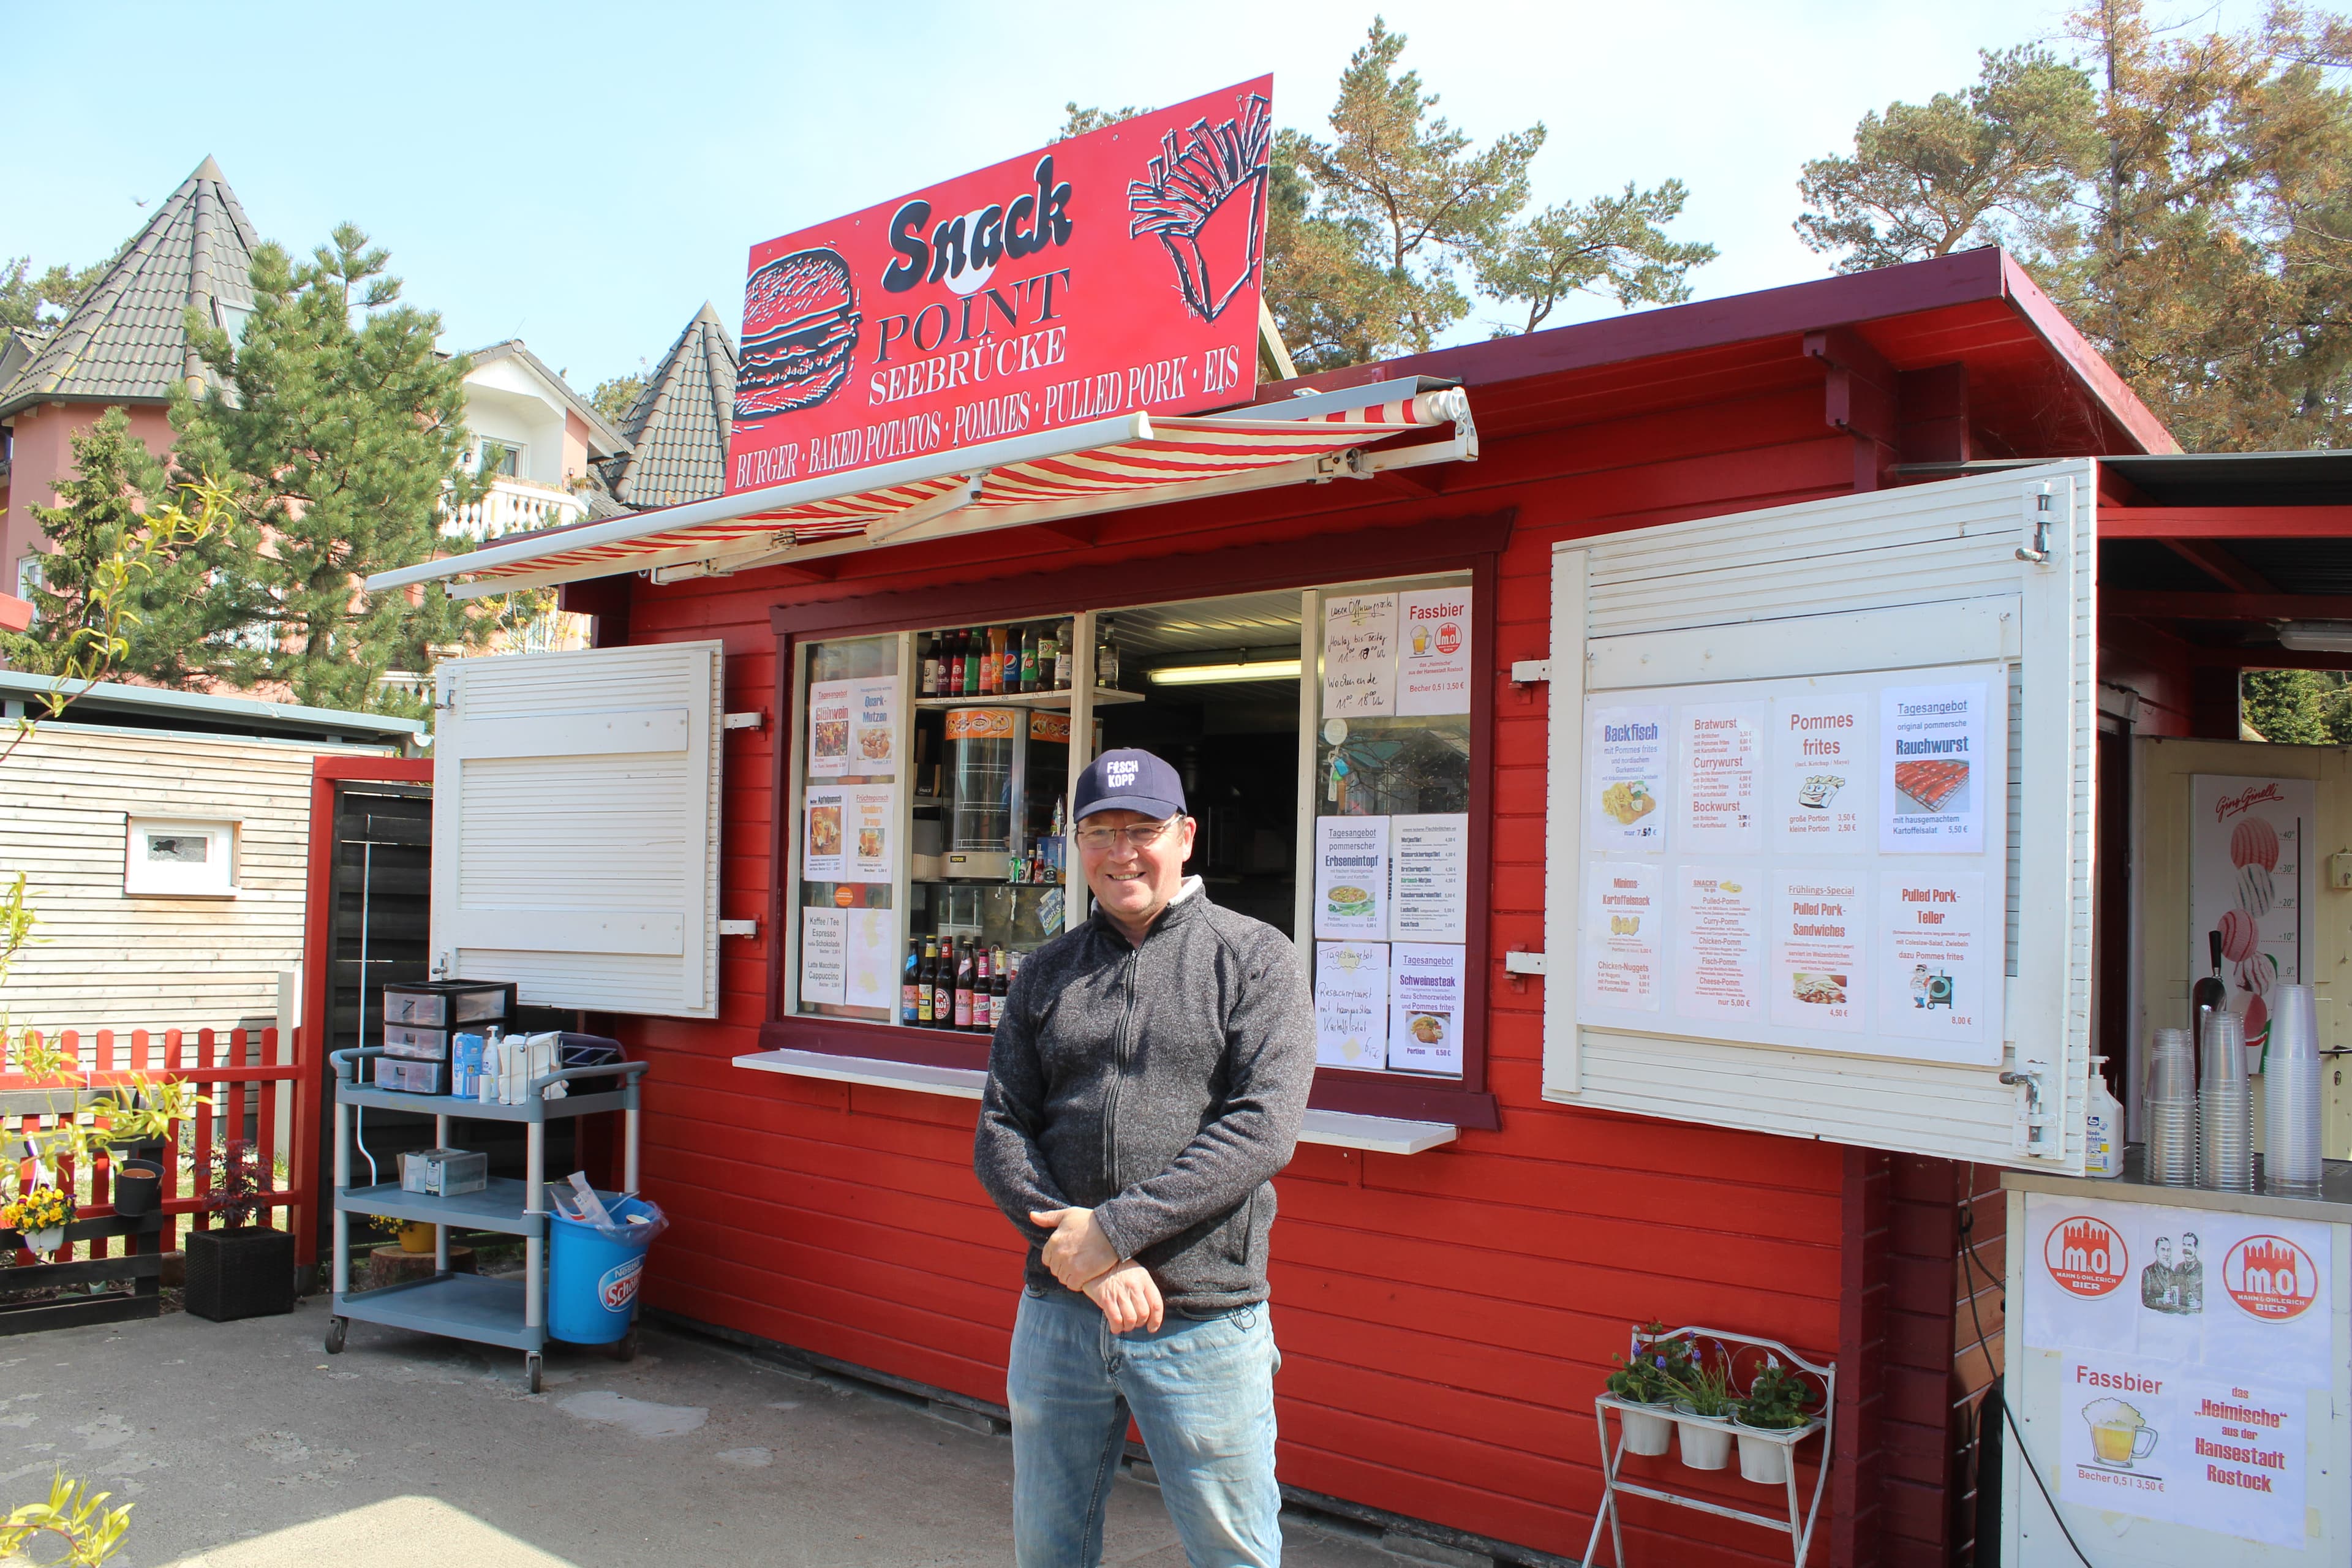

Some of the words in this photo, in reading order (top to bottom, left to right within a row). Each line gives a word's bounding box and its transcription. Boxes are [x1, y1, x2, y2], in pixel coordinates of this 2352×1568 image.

[881, 156, 1072, 292] Snack
[872, 269, 1069, 364] POINT
[869, 325, 1066, 407] SEEBRÜCKE
[736, 446, 798, 488] BURGER
[808, 429, 861, 474] BAKED
[864, 410, 941, 464] POTATOS
[953, 391, 1030, 447] POMMES
[1044, 371, 1120, 426] PULLED
[1127, 355, 1186, 412] PORK
[1203, 345, 1238, 394] EIS
[1410, 603, 1464, 620] Fassbier
[865, 696, 886, 708] Quark-
[1898, 700, 1967, 715] Tagesangebot
[816, 706, 848, 720] Glühwein
[1695, 718, 1737, 730] Bratwurst
[1791, 714, 1853, 730] Pommes
[1898, 723, 1922, 731] original
[1924, 720, 1967, 730] pommersche
[1604, 723, 1658, 742] Backfisch
[1803, 739, 1841, 755] frites
[1896, 736, 1969, 755] Rauchwurst
[1694, 756, 1743, 770] Currywurst
[1108, 774, 1135, 788] KOPP
[1694, 801, 1740, 812] Bockwurst
[2215, 796, 2241, 823] Gino
[2241, 783, 2278, 812] Ginelli
[1789, 815, 1806, 824] große
[1838, 813, 1851, 823] 3,50
[1905, 815, 1959, 824] hausgemachtem
[1329, 828, 1376, 838] Tagesangebot
[1329, 842, 1375, 851] pommerscher
[1325, 855, 1378, 868] Erbseneintopf
[1613, 878, 1639, 889] Minions-
[1789, 885, 1855, 895] Frühlings-Special
[1602, 894, 1650, 906] Kartoffelsnack
[1902, 889, 1930, 902] Pulled
[1933, 889, 1961, 903] Pork-
[1793, 902, 1819, 916] Pulled
[1822, 903, 1847, 916] Pork-
[810, 917, 826, 925] Kaffee
[1703, 917, 1738, 926] Curry-Pomm
[1917, 911, 1945, 924] Teller
[812, 929, 836, 938] Espresso
[1793, 923, 1845, 937] Sandwiches
[1403, 955, 1453, 966] Tagesangebot
[1917, 952, 1945, 960] Pommes
[1947, 952, 1964, 961] frites
[1598, 960, 1649, 973] Chicken-Nuggets
[809, 971, 839, 981] Cappuccino
[1400, 974, 1455, 987] Schweinesteak
[1700, 977, 1740, 986] Cheese-Pomm
[1951, 1016, 1966, 1025] 8,00
[2072, 1281, 2100, 1291] BIER
[2081, 1275, 2116, 1284] OHLERICH
[2266, 1297, 2305, 1305] OHLERICH
[2255, 1303, 2287, 1313] BIER
[2076, 1365, 2162, 1395] Fassbier
[2232, 1386, 2248, 1400] das
[2194, 1398, 2288, 1428] „Heimische“
[2222, 1425, 2238, 1438] aus
[2241, 1427, 2258, 1441] der
[2195, 1437, 2285, 1470] Hansestadt
[2078, 1469, 2111, 1484] Becher
[2113, 1472, 2128, 1487] 0,5
[2136, 1476, 2156, 1491] 3,50
[2157, 1481, 2165, 1492] €
[2206, 1464, 2272, 1493] Rostock
